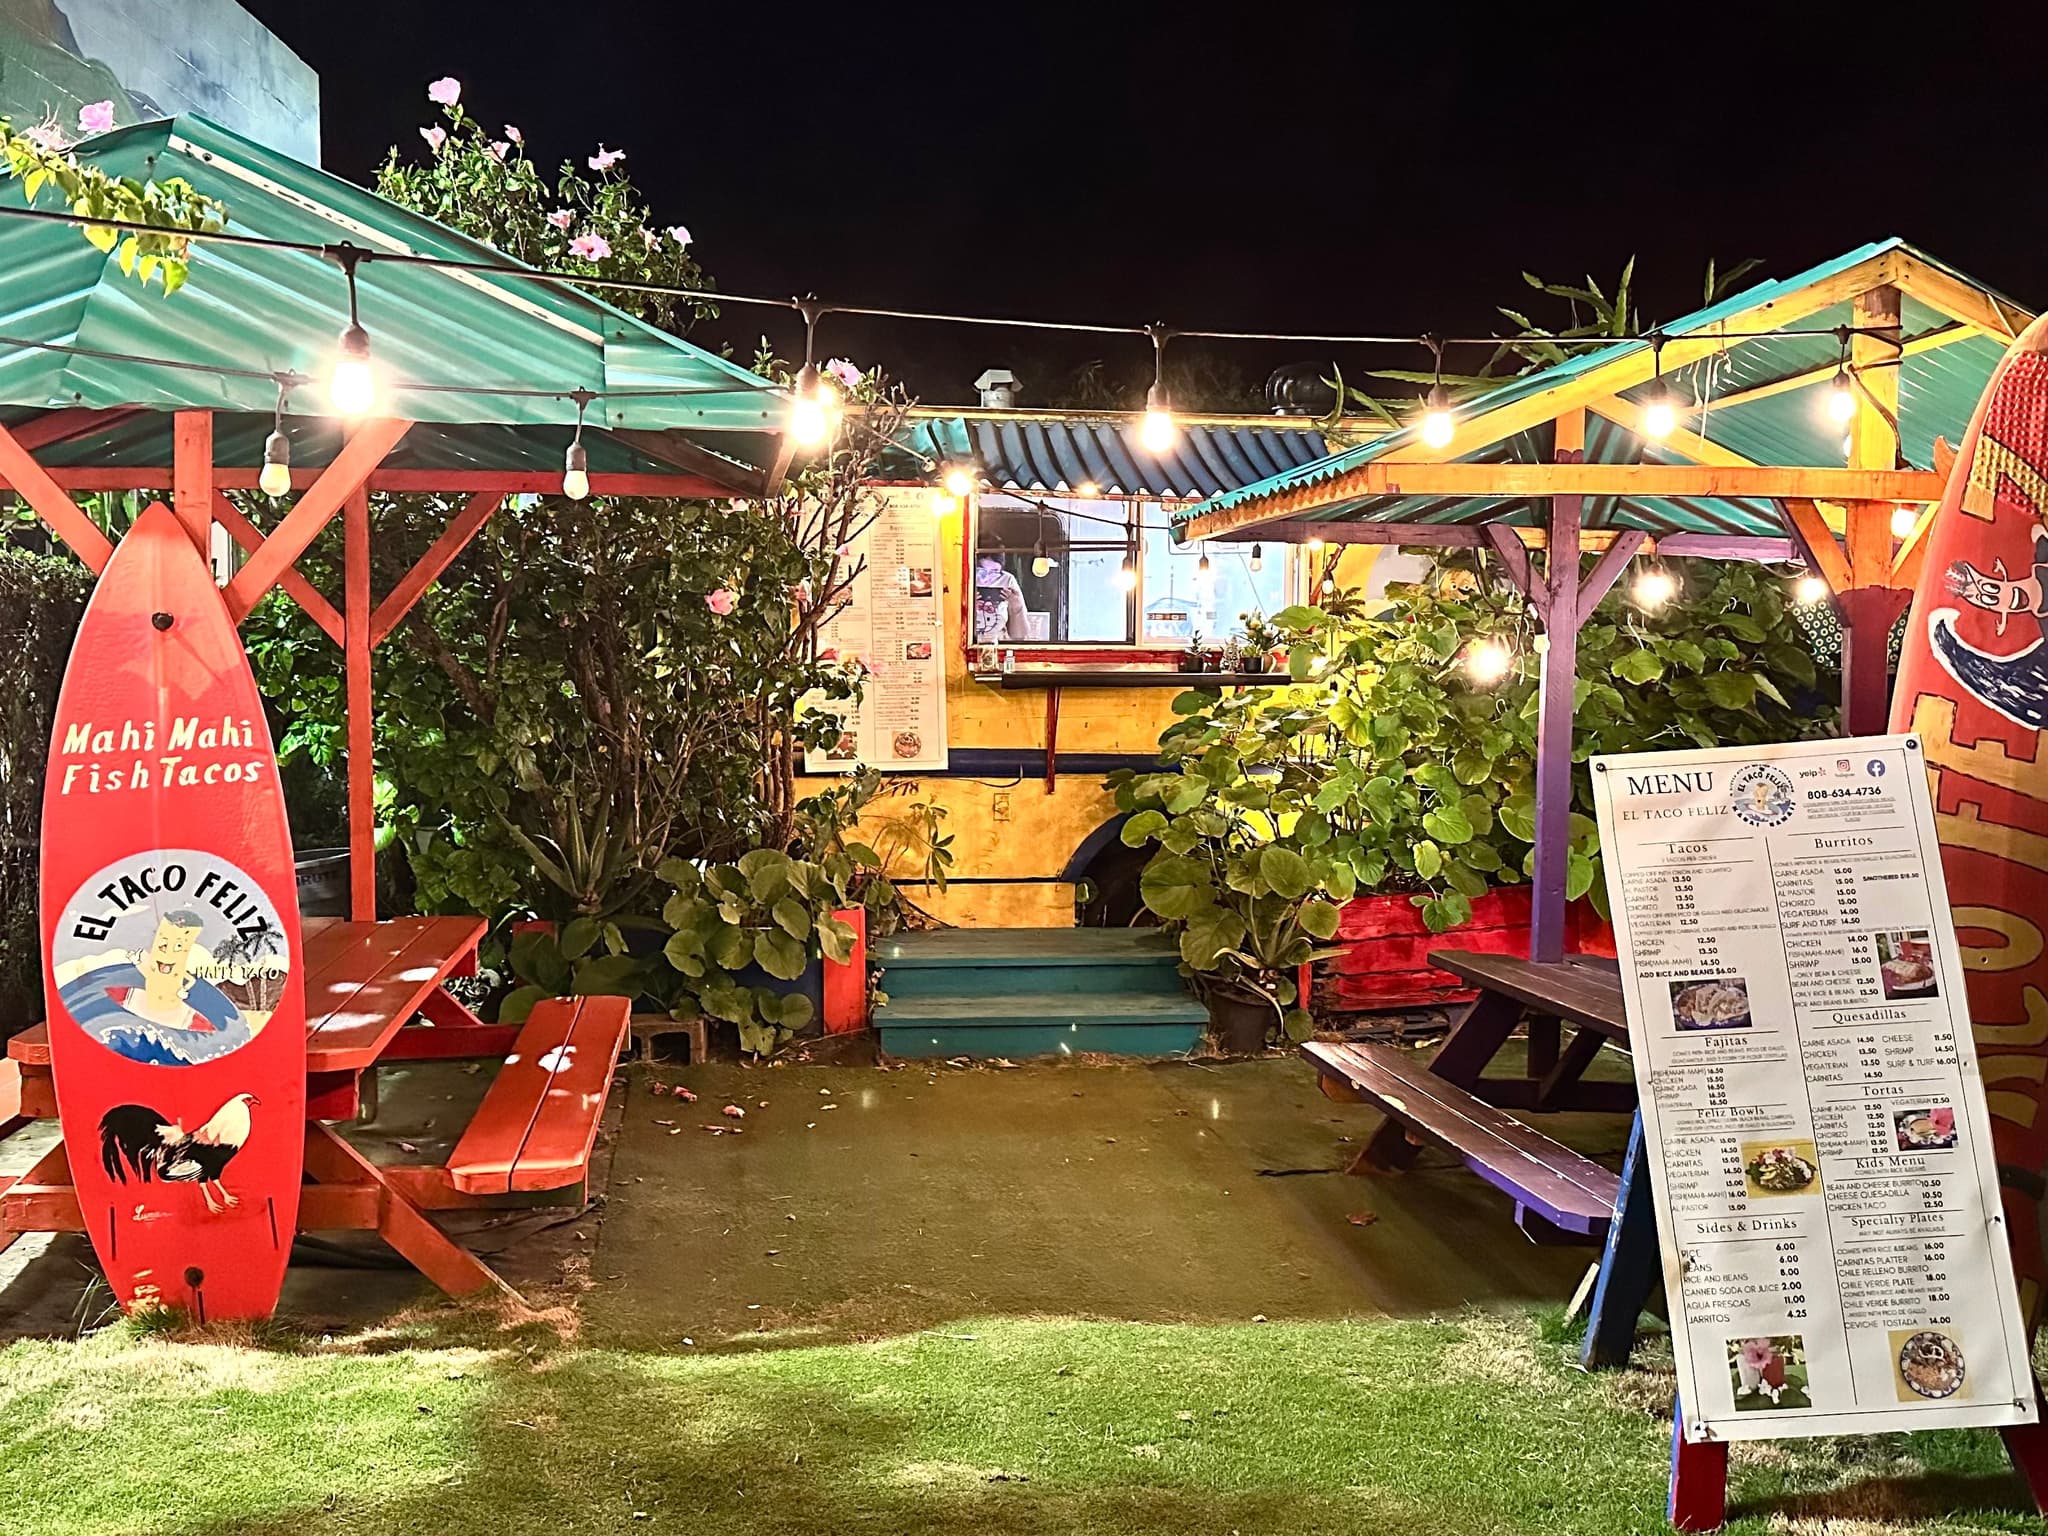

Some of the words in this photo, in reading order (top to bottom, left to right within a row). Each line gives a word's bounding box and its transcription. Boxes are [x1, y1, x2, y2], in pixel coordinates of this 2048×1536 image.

[61, 719, 155, 756] Mahi
[167, 715, 253, 751] Mahi
[61, 759, 151, 796] Fish
[159, 755, 265, 788] Tacos
[1741, 770, 1763, 783] TACO
[1626, 770, 1716, 797] MENU
[1737, 783, 1746, 792] EL
[1806, 785, 1882, 800] 808-634-4736
[1622, 810, 1639, 821] EL
[1643, 807, 1683, 820] TACO
[1687, 803, 1729, 817] FELIZ
[1665, 840, 1709, 855] Tacos
[1813, 834, 1874, 849] Burritos
[1774, 869, 1799, 877] CARNE
[1799, 867, 1824, 875] ASADA
[1776, 878, 1813, 887] CARNITAS
[72, 915, 117, 942] EL
[97, 864, 187, 911] TACO
[193, 871, 268, 943] FELIZ
[1779, 899, 1815, 907] CHORIZO
[1839, 907, 1859, 915] 14.00
[1819, 918, 1838, 926] TURF
[1633, 938, 1664, 947] CHICKEN
[1696, 936, 1716, 944] 12.50
[1785, 938, 1821, 948] CHICKEN
[1698, 947, 1718, 955] 13.50
[1788, 959, 1820, 968] SHRIMP
[1851, 956, 1872, 964] 15.00
[1690, 968, 1714, 976] BEANS
[1715, 966, 1737, 974] $6.00
[1832, 1007, 1907, 1024] Quesadillas
[1704, 1034, 1748, 1049] Fajitas
[1801, 1039, 1825, 1047] CARNE
[1825, 1037, 1850, 1045] ASADA
[1881, 1033, 1913, 1043] CHEESE
[1933, 1033, 1952, 1041] 11.50
[1802, 1049, 1837, 1058] CHICKEN
[1884, 1046, 1914, 1055] SHRIMP
[1934, 1045, 1954, 1053] 14.50
[1886, 1059, 1906, 1068] SURF
[1916, 1058, 1935, 1066] TURF
[1936, 1057, 1957, 1065] 16.00
[1706, 1075, 1723, 1083] 15.50
[1806, 1073, 1843, 1083] CARNITAS
[1861, 1084, 1904, 1096] Tortas
[1697, 1108, 1726, 1118] Feliz
[1729, 1105, 1764, 1116] Bowls
[1834, 1104, 1856, 1112] ASADA
[1866, 1112, 1884, 1120] 12.50
[1813, 1121, 1848, 1130] CARNITAS
[1690, 1136, 1715, 1144] ASADA
[1870, 1138, 1887, 1146] 13.50
[1664, 1149, 1701, 1158] CHICKEN
[1720, 1146, 1738, 1154] 14.50
[1665, 1159, 1703, 1168] CARNITAS
[1855, 1157, 1884, 1169] Kids
[1889, 1155, 1925, 1167] Menu
[1723, 1167, 1742, 1175] 14.50
[1825, 1184, 1845, 1192] BEAN
[1846, 1182, 1861, 1190] AND
[1862, 1181, 1890, 1189] CHEESE
[1921, 1179, 1941, 1187] 10.50
[1728, 1190, 1747, 1198] 16.00
[1826, 1192, 1859, 1201] CHEESE
[1859, 1188, 1909, 1199] QUESADILLA
[1921, 1191, 1943, 1199] 10.50
[1828, 1202, 1862, 1212] CHICKEN
[1863, 1201, 1887, 1209] TACO
[1924, 1200, 1944, 1208] 12.50
[1696, 1221, 1732, 1234] Sides
[1736, 1221, 1746, 1231] &
[1751, 1217, 1797, 1231] Drinks
[1851, 1214, 1905, 1228] Specialty
[1909, 1212, 1944, 1223] Plates
[1775, 1242, 1795, 1250] 6.00
[1778, 1255, 1798, 1263] 6.00
[1836, 1257, 1875, 1267] CARNITAS
[1876, 1255, 1908, 1264] PLATTER
[1924, 1253, 1945, 1261] 16.00
[1703, 1274, 1720, 1282] AND
[1722, 1273, 1748, 1281] BEANS
[1779, 1268, 1799, 1276] 8.00
[1838, 1269, 1861, 1277] CHILE
[1861, 1266, 1896, 1276] RELLENO
[1897, 1264, 1929, 1273] BURRITO
[1840, 1280, 1862, 1289] CHILE
[1864, 1279, 1890, 1288] VERDE
[1891, 1277, 1915, 1286] PLATE
[1925, 1273, 1946, 1281] 18.00
[1684, 1287, 1717, 1296] CANNED
[1719, 1286, 1742, 1295] SODA
[1744, 1285, 1756, 1293] OR
[1757, 1284, 1779, 1292] JUICE
[1781, 1282, 1802, 1290] 2.00
[1686, 1301, 1710, 1310] AGUA
[1712, 1299, 1751, 1309] FRESCAS
[1784, 1295, 1805, 1303] 11.00
[1843, 1300, 1864, 1309] CHILE
[1864, 1299, 1889, 1307] VERDE
[1928, 1293, 1950, 1301] 18.00
[1688, 1314, 1730, 1324] JARRITOS
[1786, 1309, 1807, 1318] 4.25
[1845, 1320, 1878, 1329] CEVICHE
[1882, 1318, 1918, 1327] TOSTADA
[1929, 1316, 1951, 1324] 14.00
